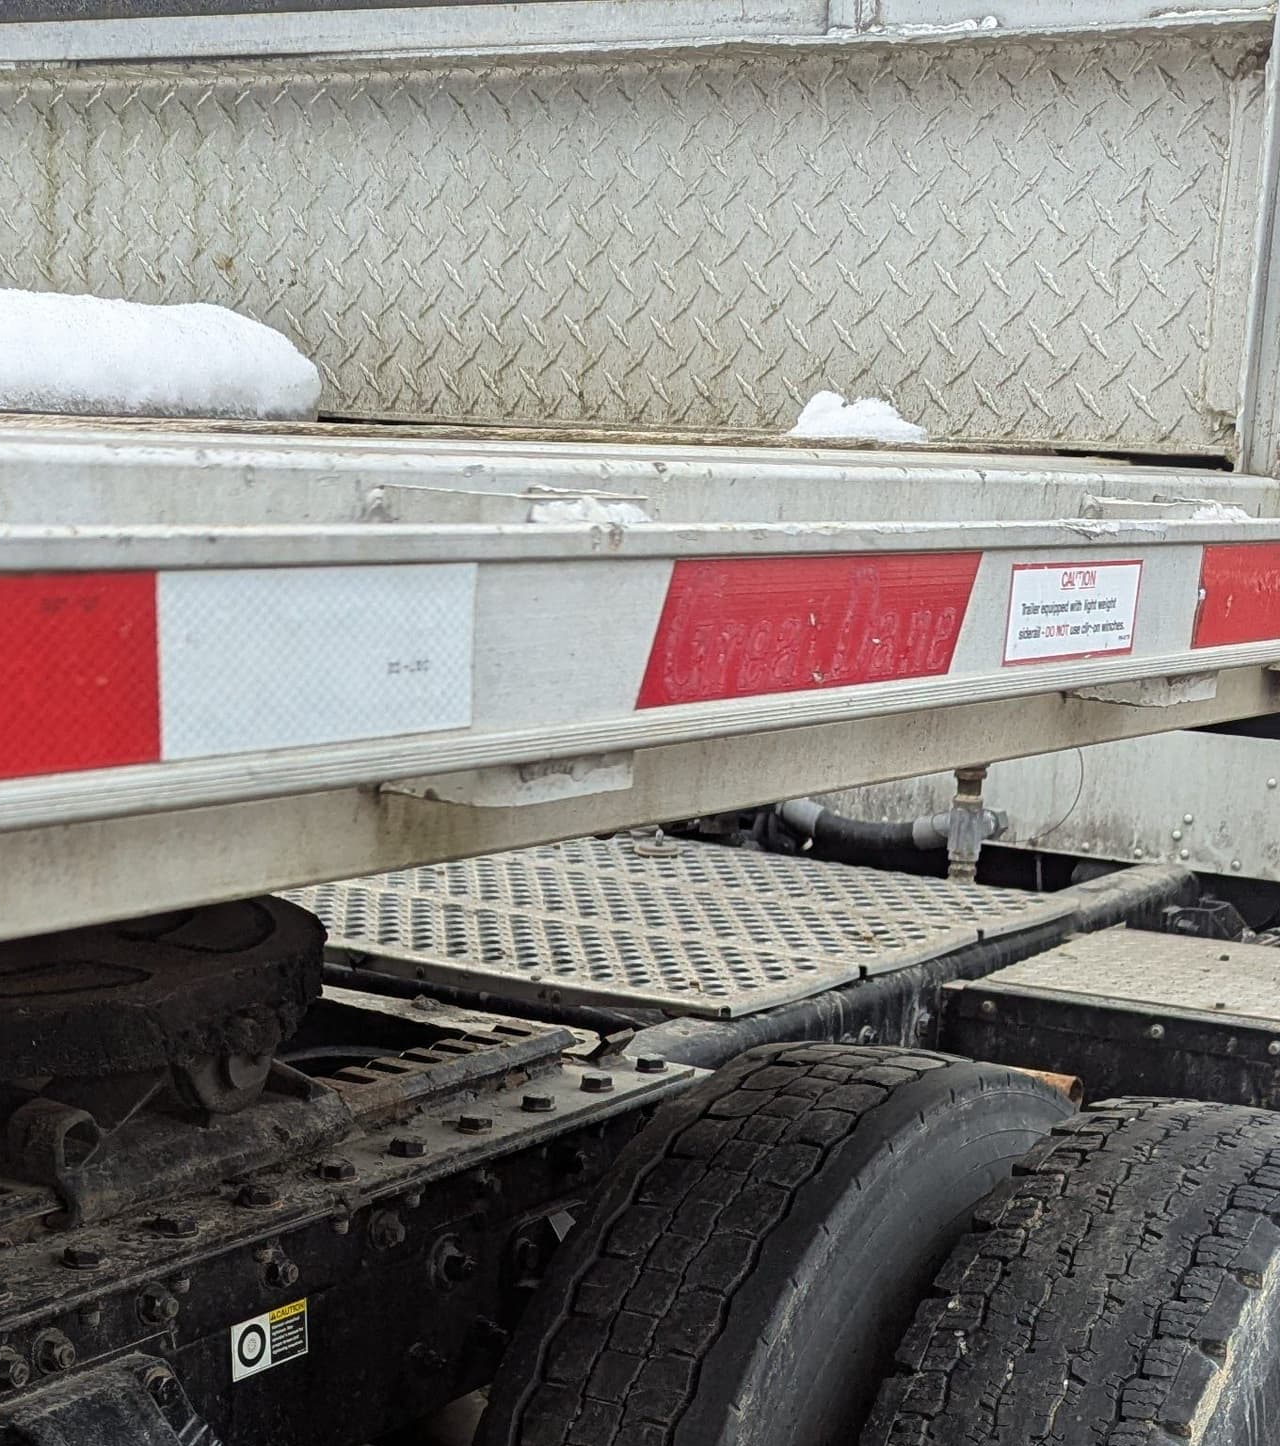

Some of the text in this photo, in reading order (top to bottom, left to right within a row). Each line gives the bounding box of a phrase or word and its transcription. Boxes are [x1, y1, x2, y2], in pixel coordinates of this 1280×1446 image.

[1022, 597, 1117, 616] Trailer equipped with light weight
[1045, 626, 1055, 638] DO
[1056, 624, 1070, 637] NOT
[1070, 625, 1080, 635] use
[276, 1302, 305, 1318] CAUTION
